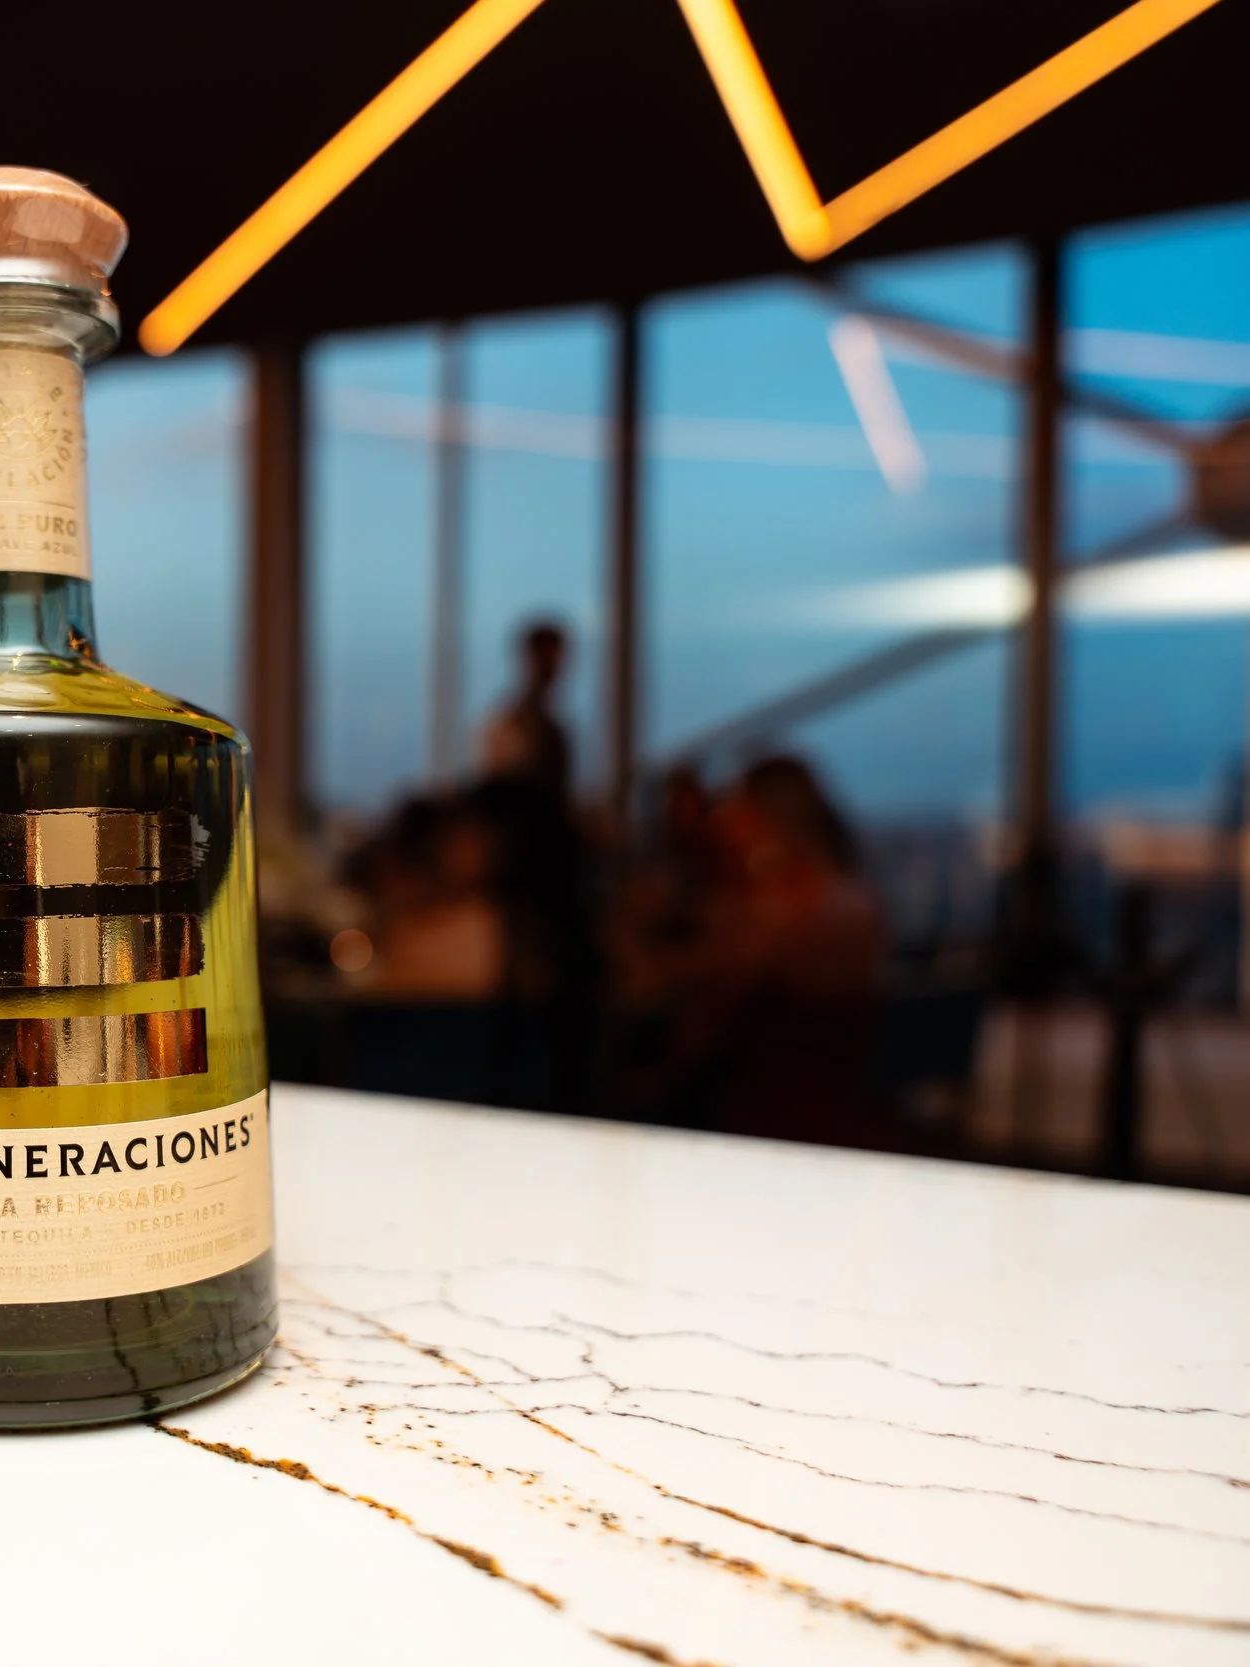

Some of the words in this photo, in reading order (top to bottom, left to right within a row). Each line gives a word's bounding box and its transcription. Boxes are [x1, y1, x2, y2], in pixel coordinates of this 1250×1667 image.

[18, 513, 79, 537] PURO
[34, 1181, 184, 1218] REPOSADO
[1, 1227, 92, 1245] TEQUILA
[127, 1212, 185, 1235] DESDE
